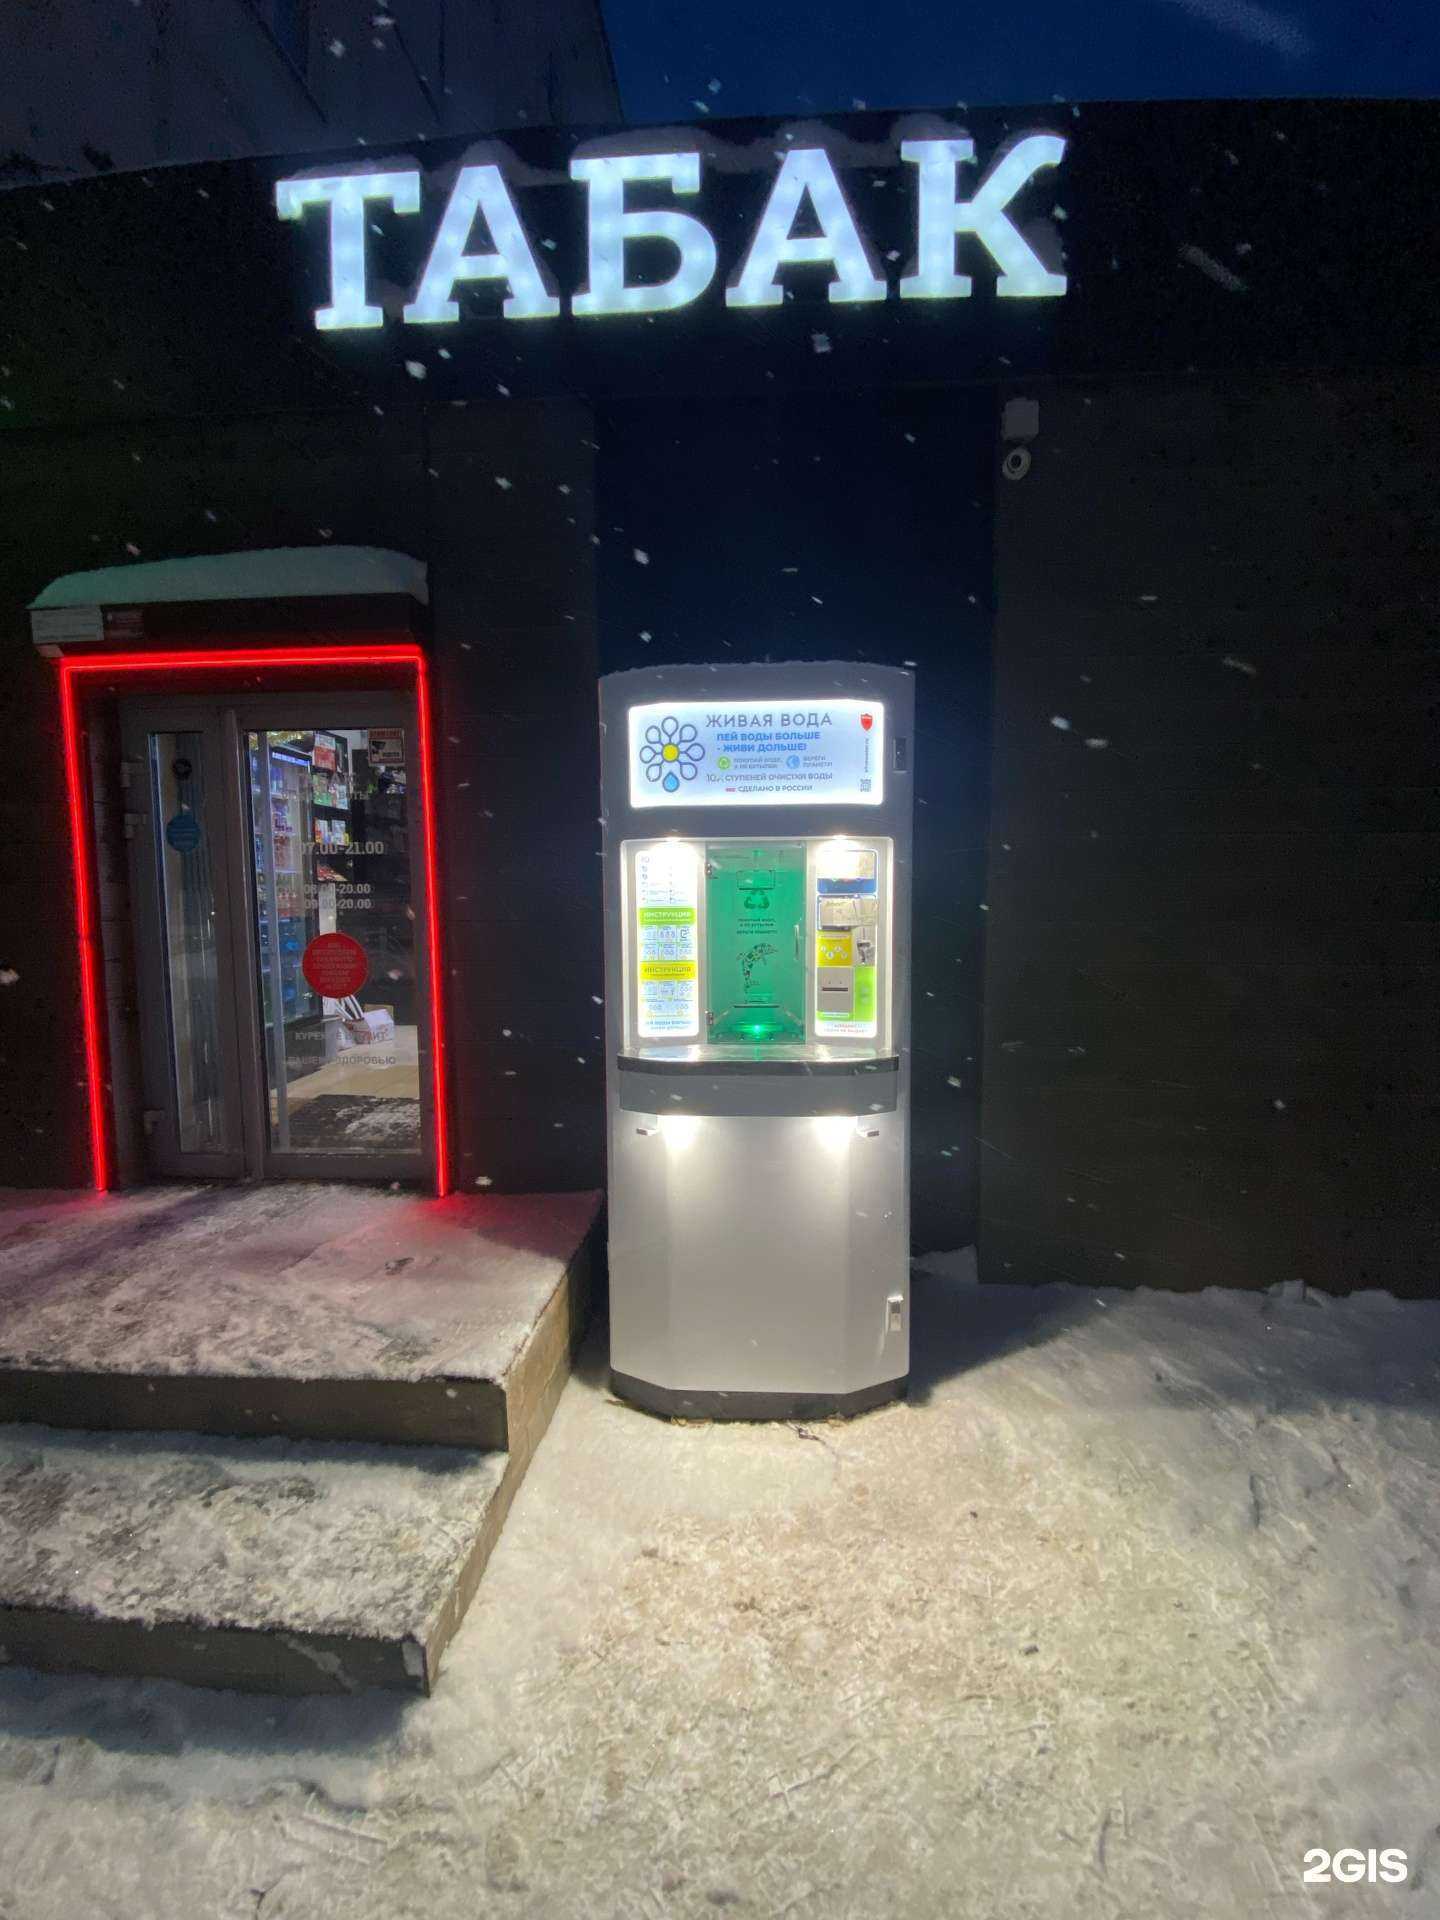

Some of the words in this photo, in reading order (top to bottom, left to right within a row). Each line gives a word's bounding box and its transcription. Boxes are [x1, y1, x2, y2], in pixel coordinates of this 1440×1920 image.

[276, 135, 1066, 329] ТАБАК
[706, 714, 772, 728] ЖИВАЯ
[781, 713, 833, 728] ВОДА
[717, 731, 738, 741] ПЕЙ
[741, 732, 771, 742] ВОДЫ
[776, 731, 820, 741] БОЛЬШЕ
[723, 743, 756, 752] ЖИВИ
[758, 743, 807, 752] ДОЛЬШЕ!
[725, 772, 766, 782] СТУПЕНЕЙ
[769, 773, 806, 782] ОЧИСТКИ
[808, 772, 833, 781] ВОДЫ
[738, 785, 773, 793] СДЕЛАНО
